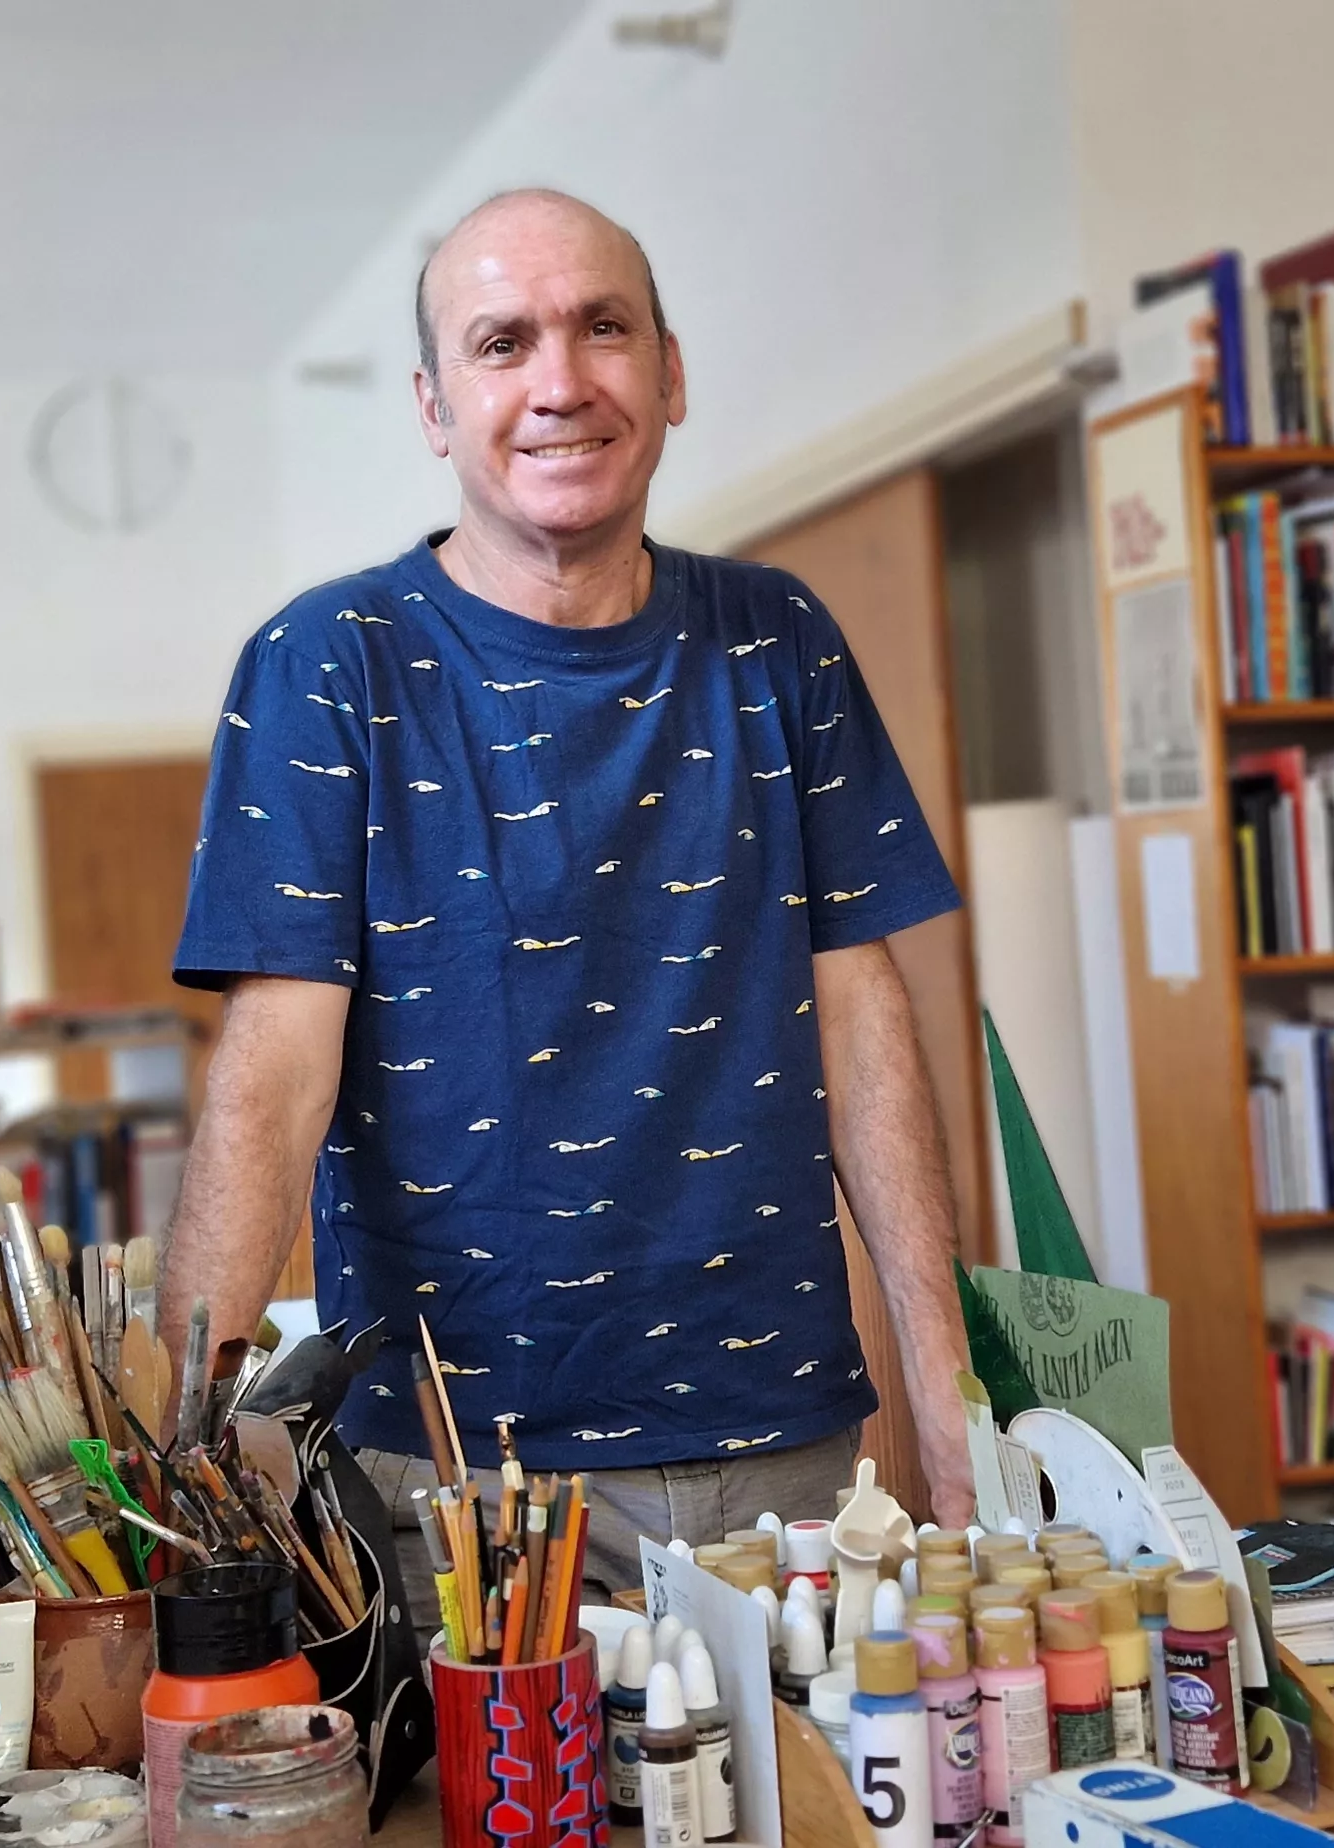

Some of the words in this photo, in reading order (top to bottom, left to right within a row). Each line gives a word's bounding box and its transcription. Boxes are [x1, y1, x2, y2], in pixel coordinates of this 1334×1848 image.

[1041, 1343, 1090, 1400] FLINT
[1094, 1318, 1133, 1381] NEW
[862, 1755, 906, 1829] 5
